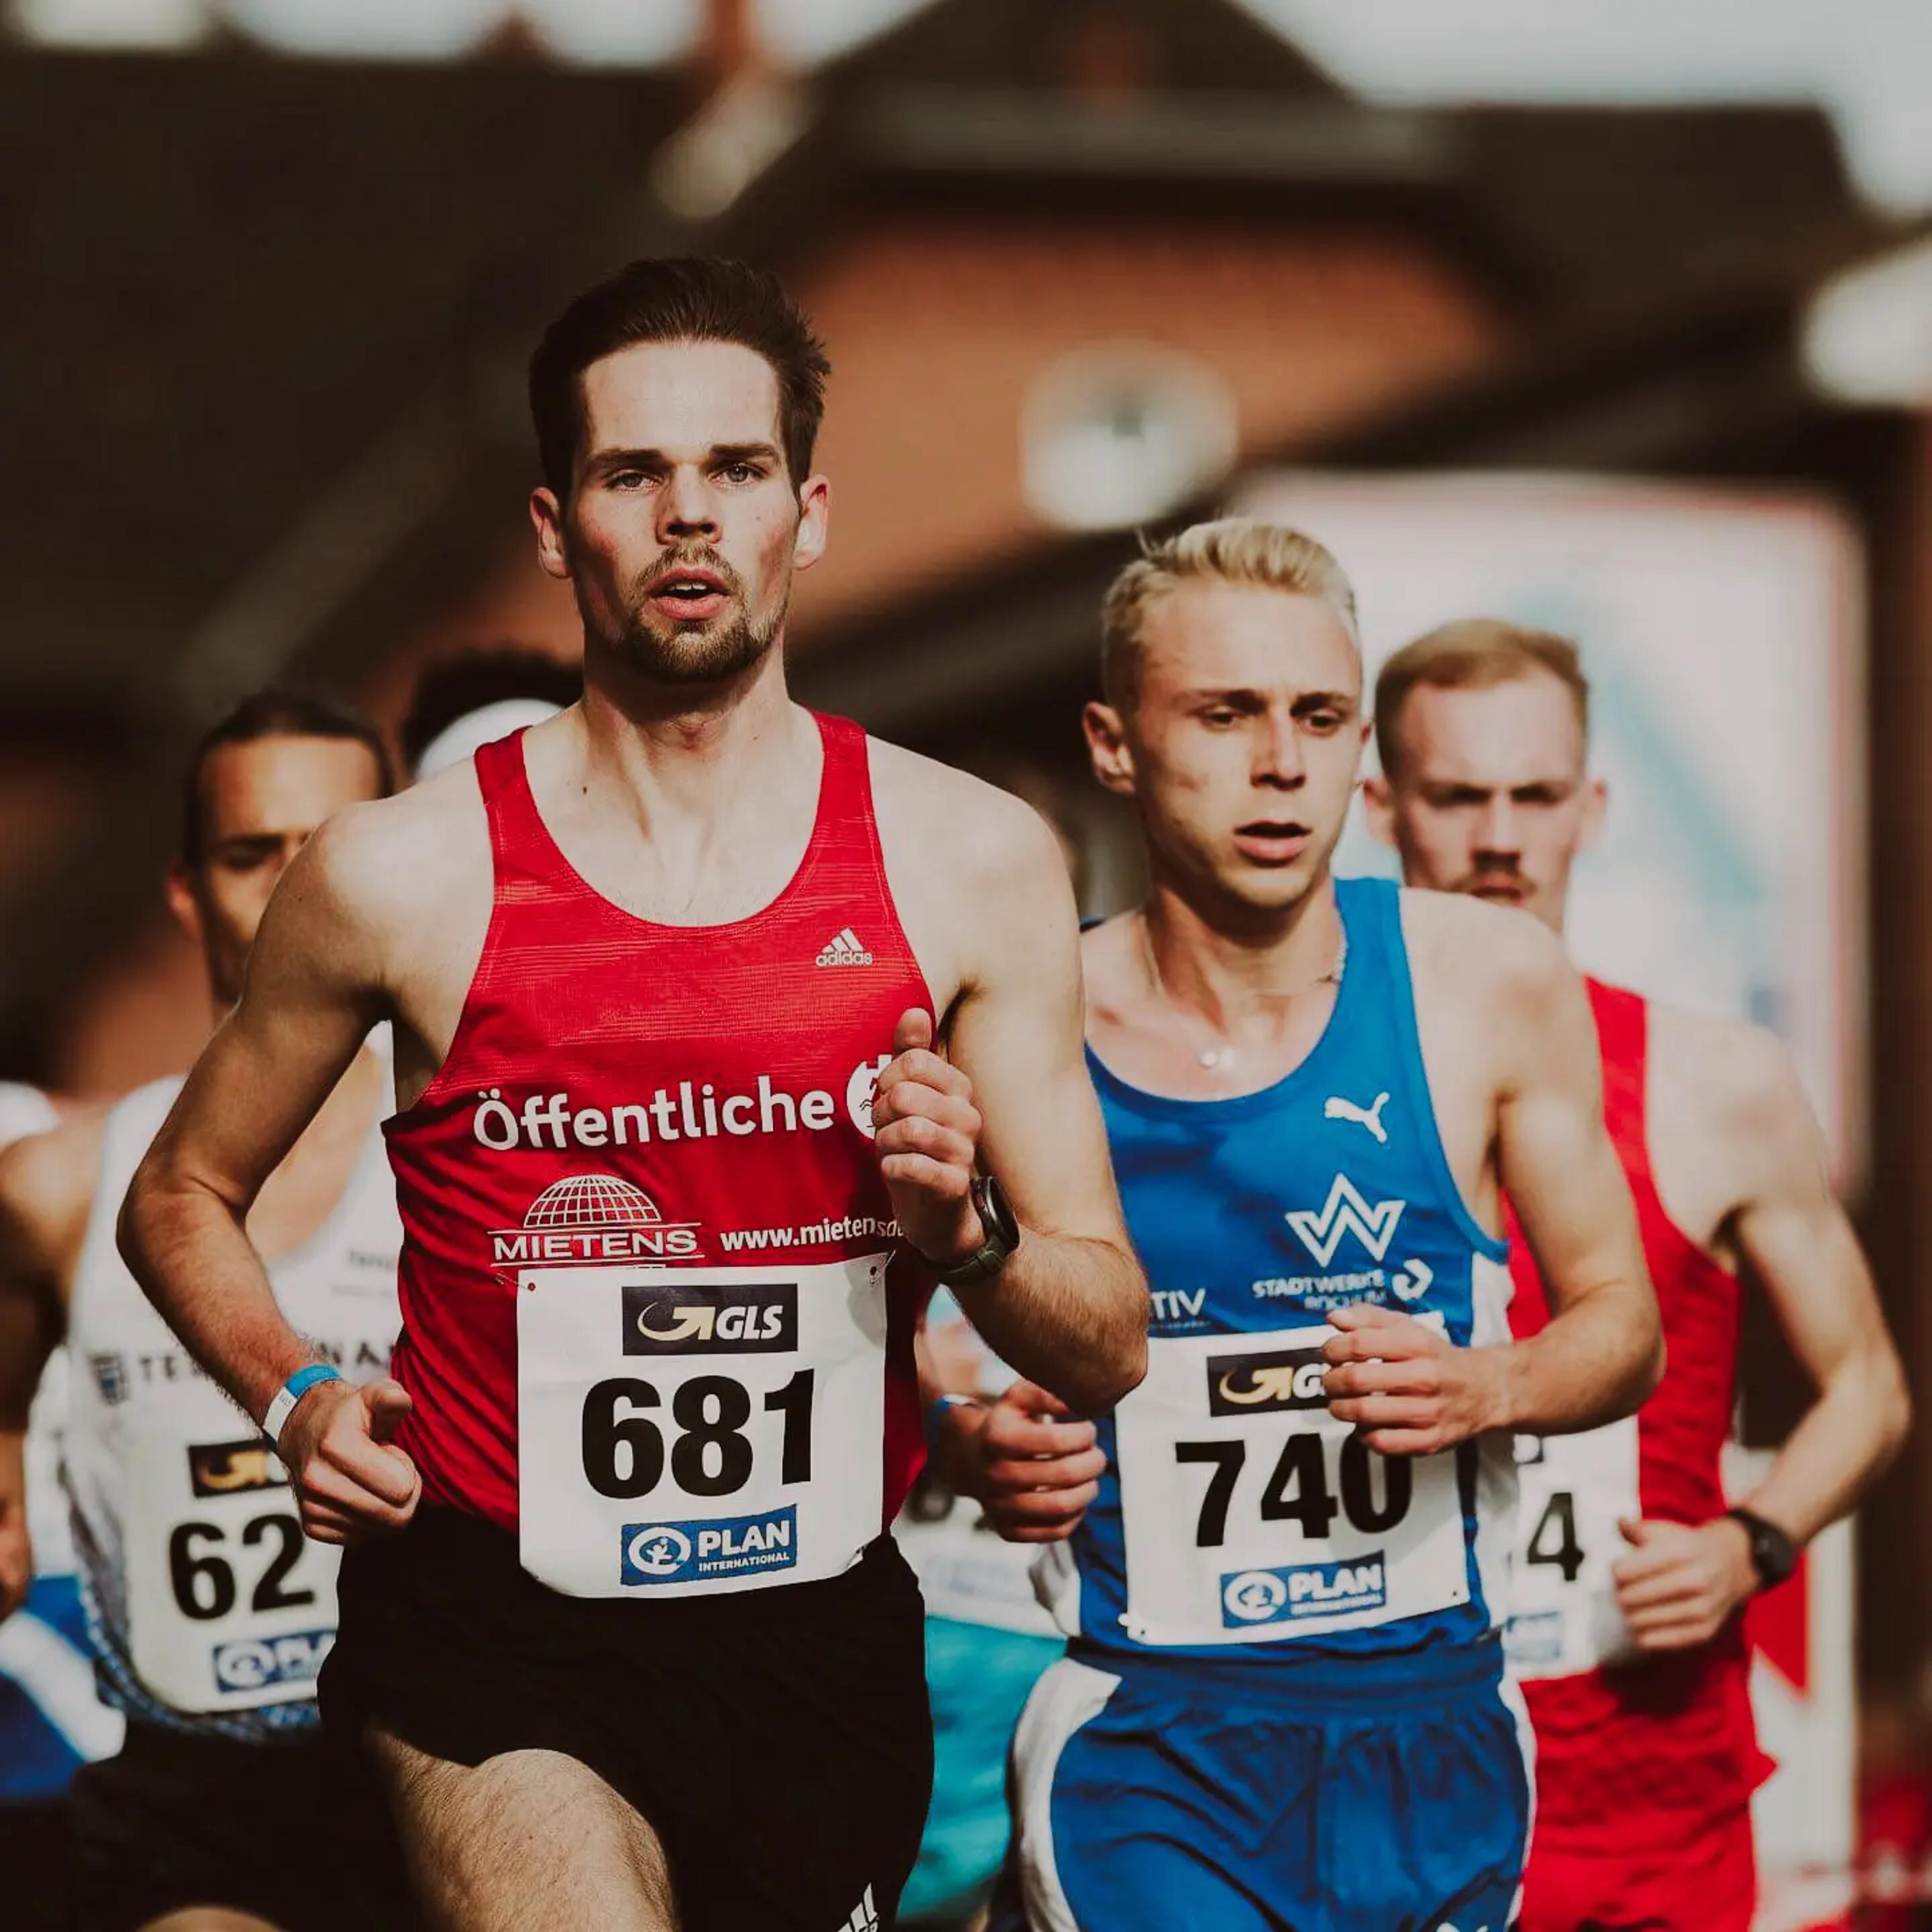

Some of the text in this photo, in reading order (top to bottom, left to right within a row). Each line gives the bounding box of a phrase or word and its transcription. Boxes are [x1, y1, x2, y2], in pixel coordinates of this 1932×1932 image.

[815, 950, 873, 967] adidas
[473, 1075, 835, 1151] Öffentliche
[493, 1229, 697, 1261] MIETENS
[1150, 1287, 1206, 1320] TIV
[715, 1305, 783, 1341] GLS
[582, 1367, 815, 1499] 681
[1175, 1432, 1413, 1548] 740
[698, 1519, 790, 1557] PLAN
[170, 1513, 315, 1621] 62
[698, 1551, 790, 1572] INTERNATIONAL
[1287, 1562, 1383, 1602] PLAN
